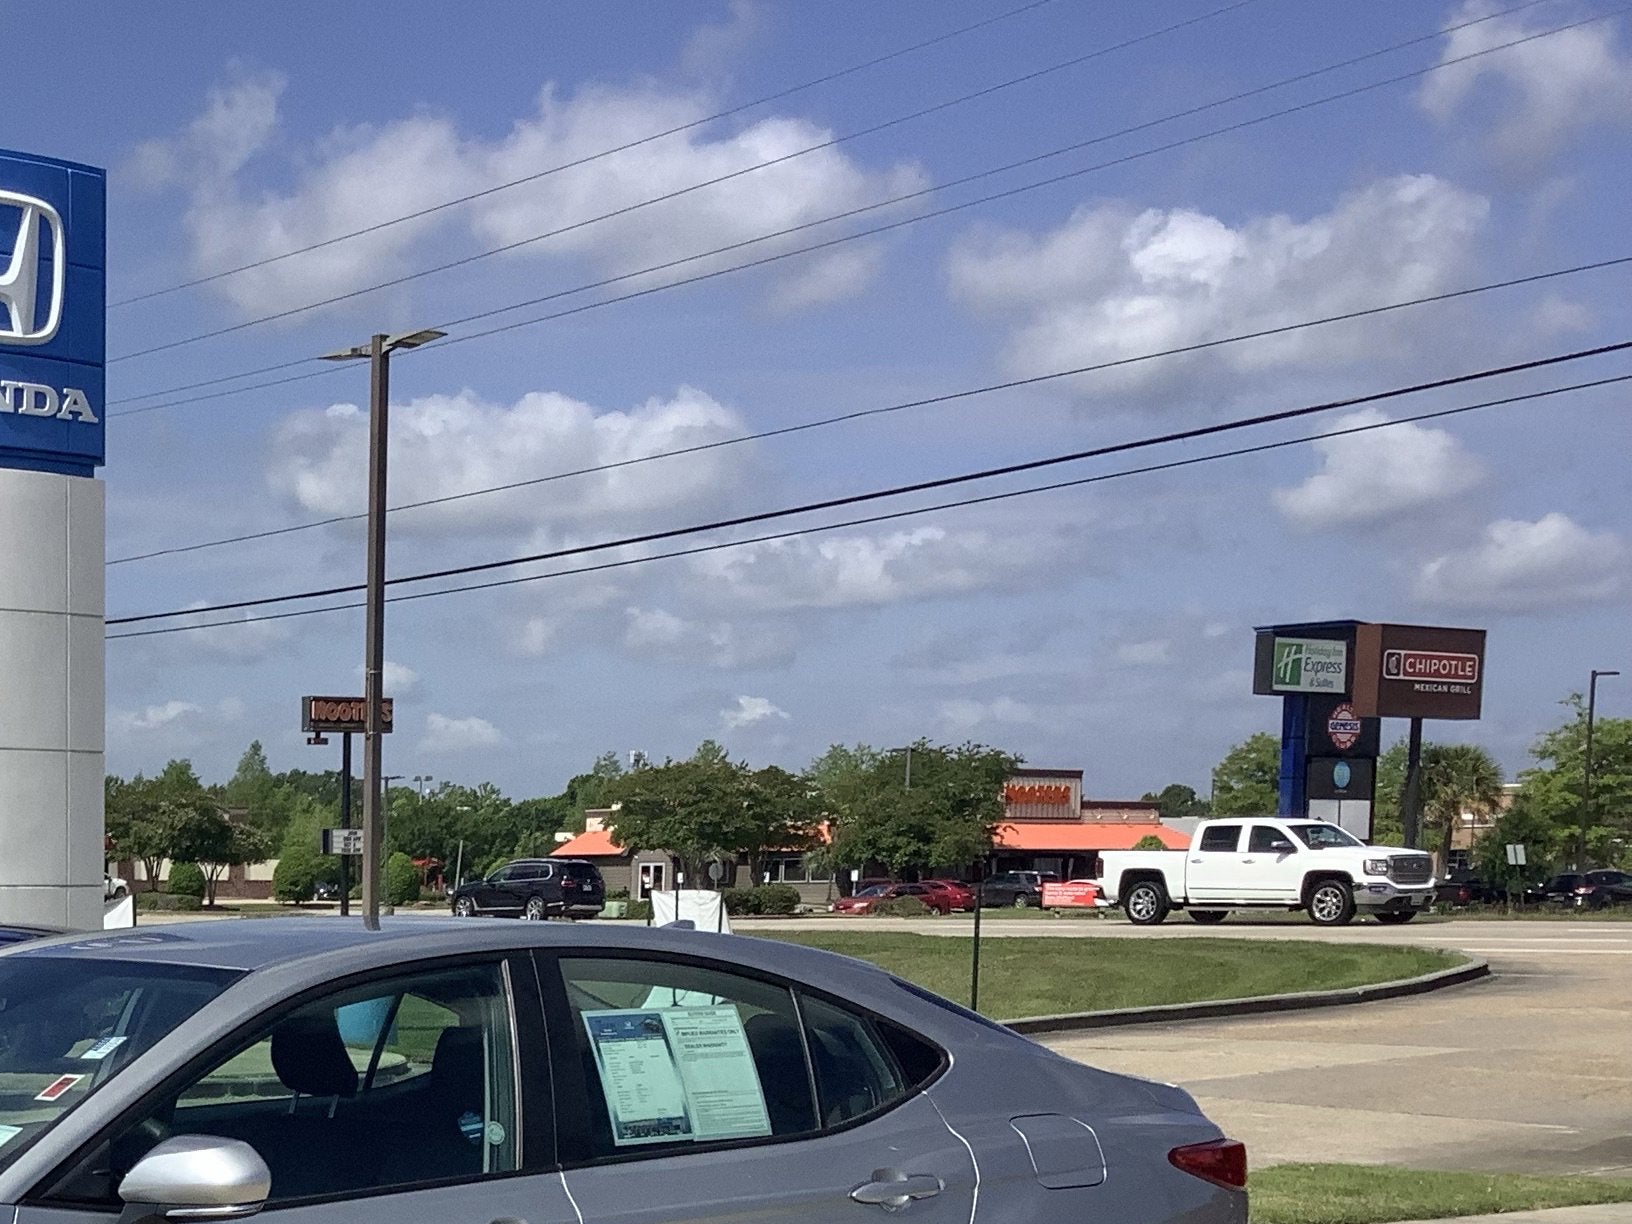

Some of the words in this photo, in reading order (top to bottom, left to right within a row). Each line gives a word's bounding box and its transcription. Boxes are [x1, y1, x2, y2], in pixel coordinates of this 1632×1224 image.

[1304, 656, 1343, 676] Express
[1405, 657, 1475, 677] CHIPOTLE
[1413, 682, 1448, 693] MEXICAN
[1449, 684, 1472, 695] GRILL
